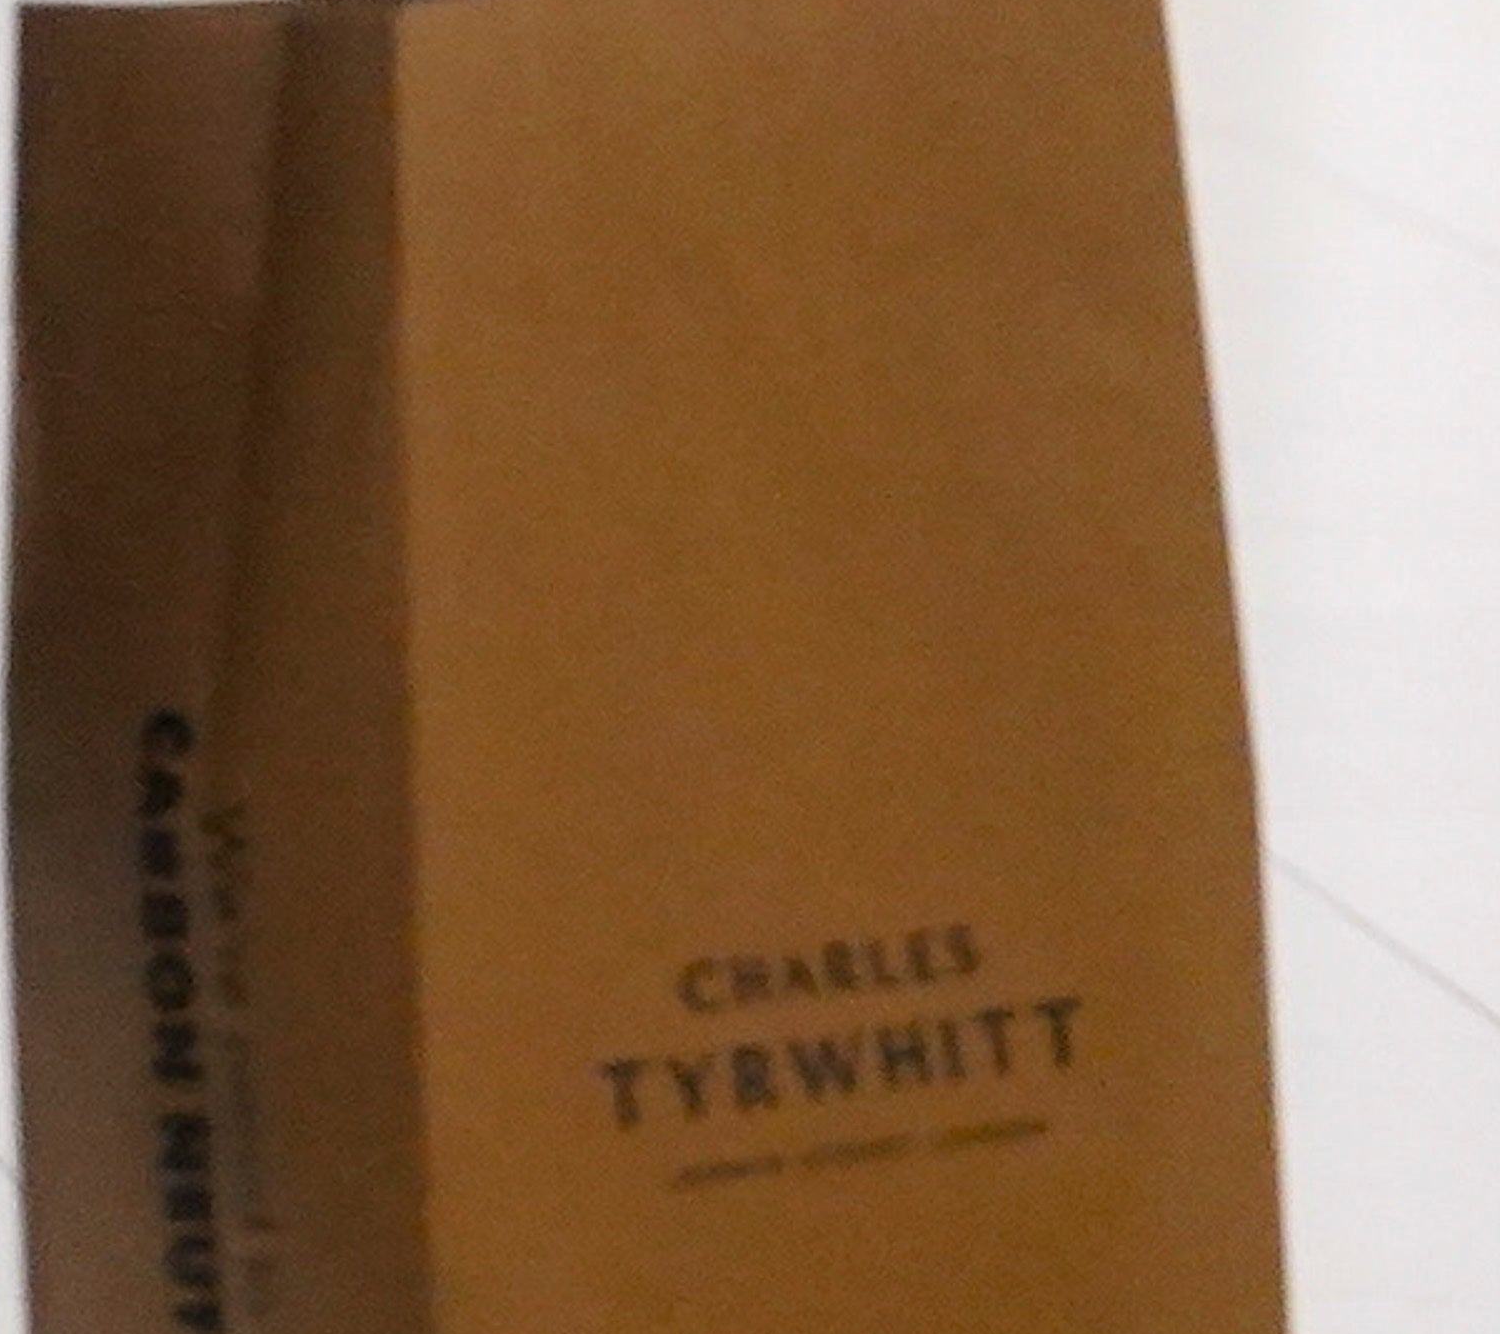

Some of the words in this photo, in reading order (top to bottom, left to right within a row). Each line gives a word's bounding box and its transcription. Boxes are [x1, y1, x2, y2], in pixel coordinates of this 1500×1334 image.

[136, 709, 205, 1084] CARBON
[676, 923, 980, 1014] CHARLES
[600, 995, 1082, 1132] TYRWHITT
